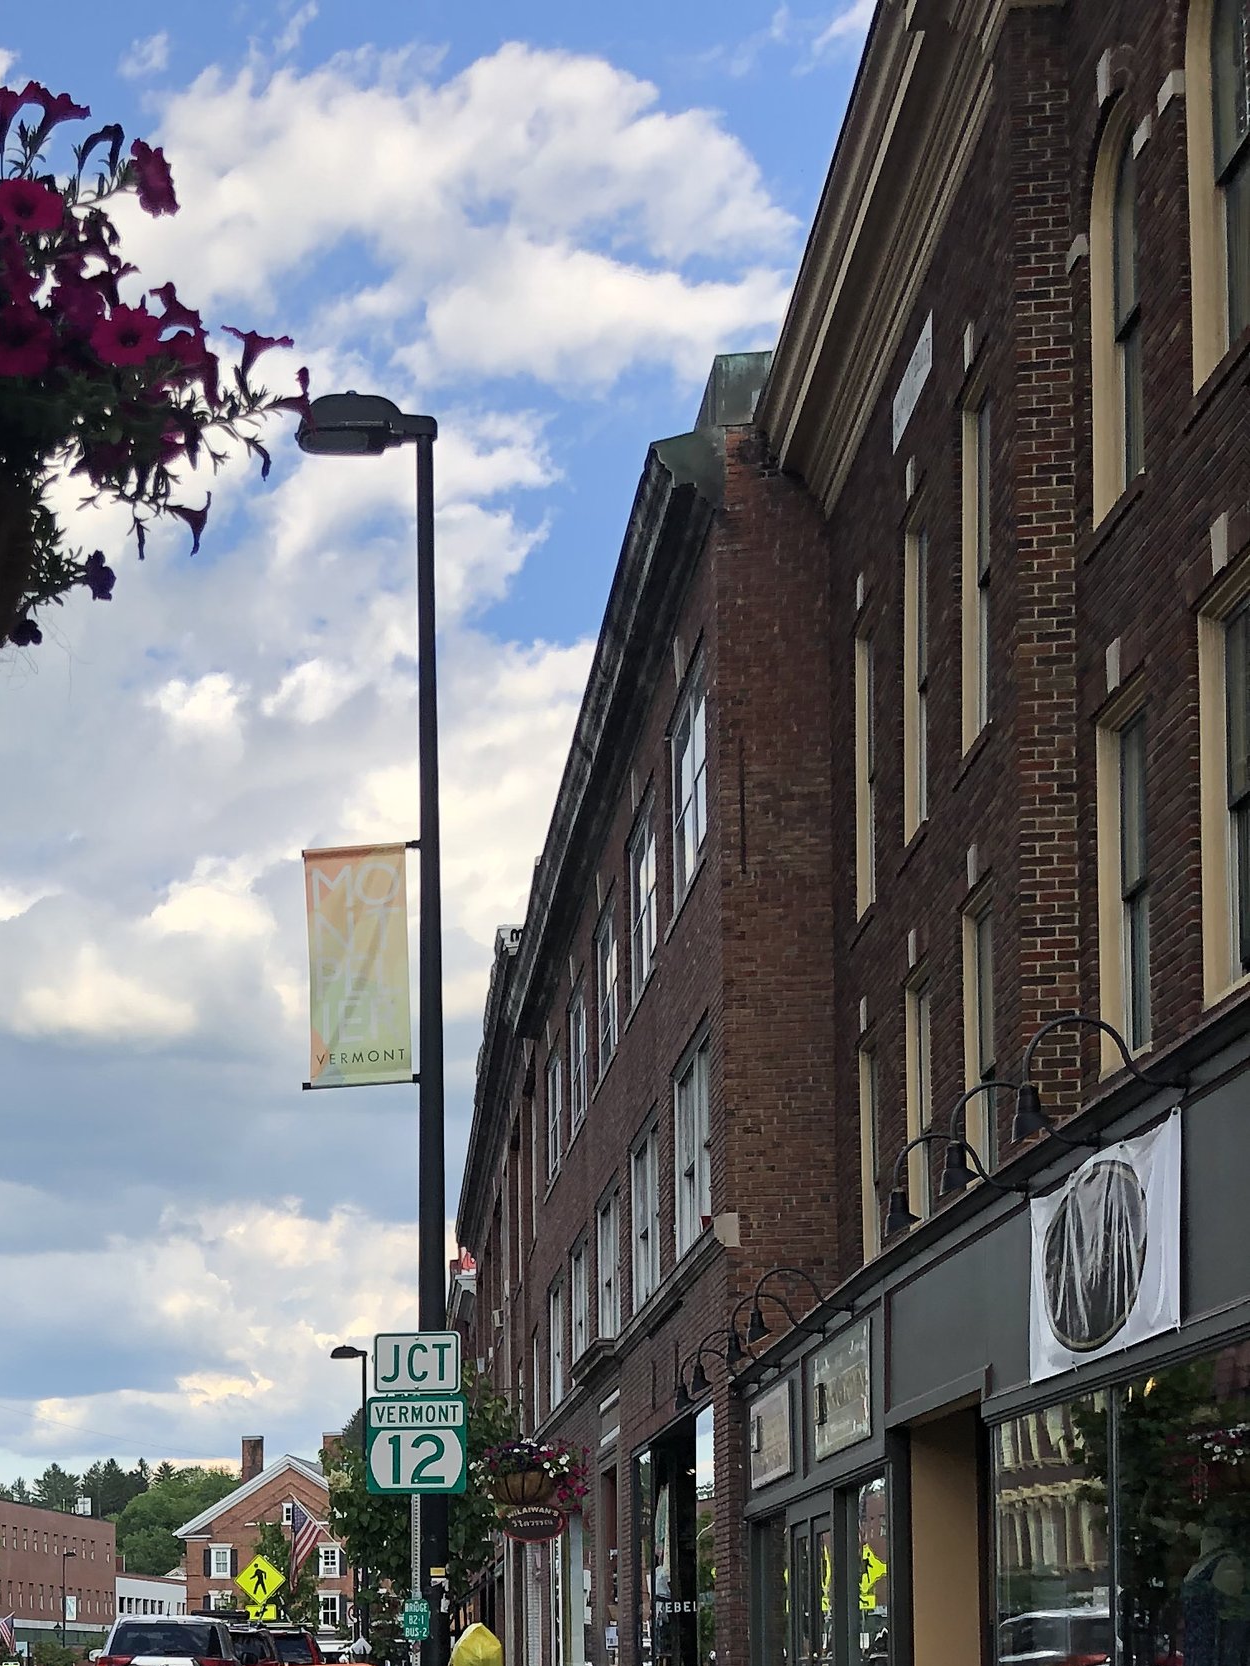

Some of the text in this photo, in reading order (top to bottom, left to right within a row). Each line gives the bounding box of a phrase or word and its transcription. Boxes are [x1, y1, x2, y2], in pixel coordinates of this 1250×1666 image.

[311, 862, 400, 907] MO
[316, 1049, 406, 1065] VERMONT
[381, 1343, 452, 1383] JCT
[375, 1405, 459, 1424] VERMONT
[388, 1433, 445, 1485] 12
[405, 1602, 427, 1613] BRIDGE
